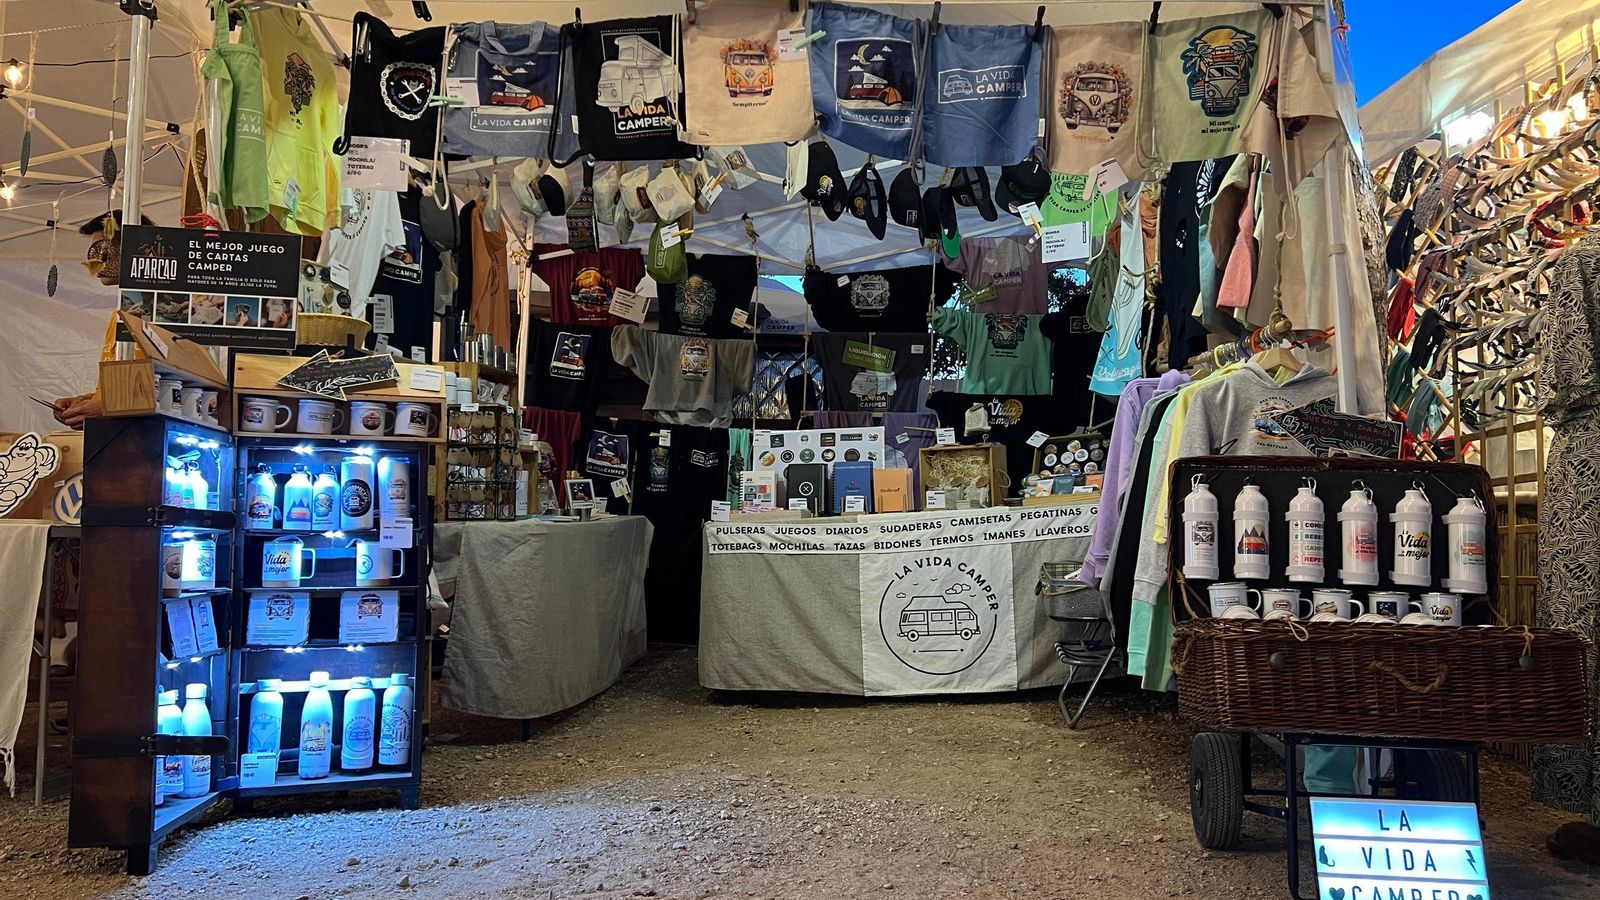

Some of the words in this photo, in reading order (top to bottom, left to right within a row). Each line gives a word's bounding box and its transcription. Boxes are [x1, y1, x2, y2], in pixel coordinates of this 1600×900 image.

[976, 74, 990, 84] LA
[992, 70, 1015, 81] VIDA
[976, 82, 1022, 93] CAMPER
[617, 107, 633, 118] LA
[477, 118, 488, 126] LA
[489, 118, 511, 127] VIDA
[513, 118, 552, 127] CAMPE
[617, 116, 668, 131] CAMPER
[871, 114, 910, 124] CAMPER
[189, 240, 201, 249] EL
[205, 241, 243, 252] MEJOR
[247, 244, 285, 254] JUEGO
[188, 251, 202, 260] DE
[206, 253, 249, 263] CARTAS
[130, 257, 178, 280] APARCAO
[187, 262, 233, 272] CAMPER
[1004, 270, 1020, 279] VIDA
[993, 277, 1022, 285] CAMPER
[988, 401, 1016, 416] Vida
[603, 467, 625, 475] CAMPER
[716, 526, 766, 535] PULSERAS
[774, 527, 817, 535] JUEGOS
[825, 526, 869, 535] DIARIOS
[880, 521, 942, 534] SUDADERAS
[950, 514, 1012, 527] CAMISETAS
[1020, 507, 1082, 521] PEGATINAS
[711, 542, 763, 551] TOTEBAGS
[769, 542, 825, 551] MOCHILAS
[833, 542, 866, 551] TAZAS
[874, 539, 922, 550] BIDONES
[930, 534, 974, 546] TERMOS
[983, 529, 1026, 541] IMANES
[1035, 525, 1090, 537] LLAVEROS
[1398, 534, 1428, 549] Vida
[264, 553, 287, 565] Vida
[1405, 549, 1430, 561] mejor
[268, 566, 290, 575] mejor
[894, 565, 912, 580] LA
[914, 556, 952, 569] VIDA
[957, 562, 999, 611] CAMPER
[1430, 606, 1450, 616] Vida
[1378, 808, 1412, 832] LA
[1361, 846, 1438, 873] VIDA
